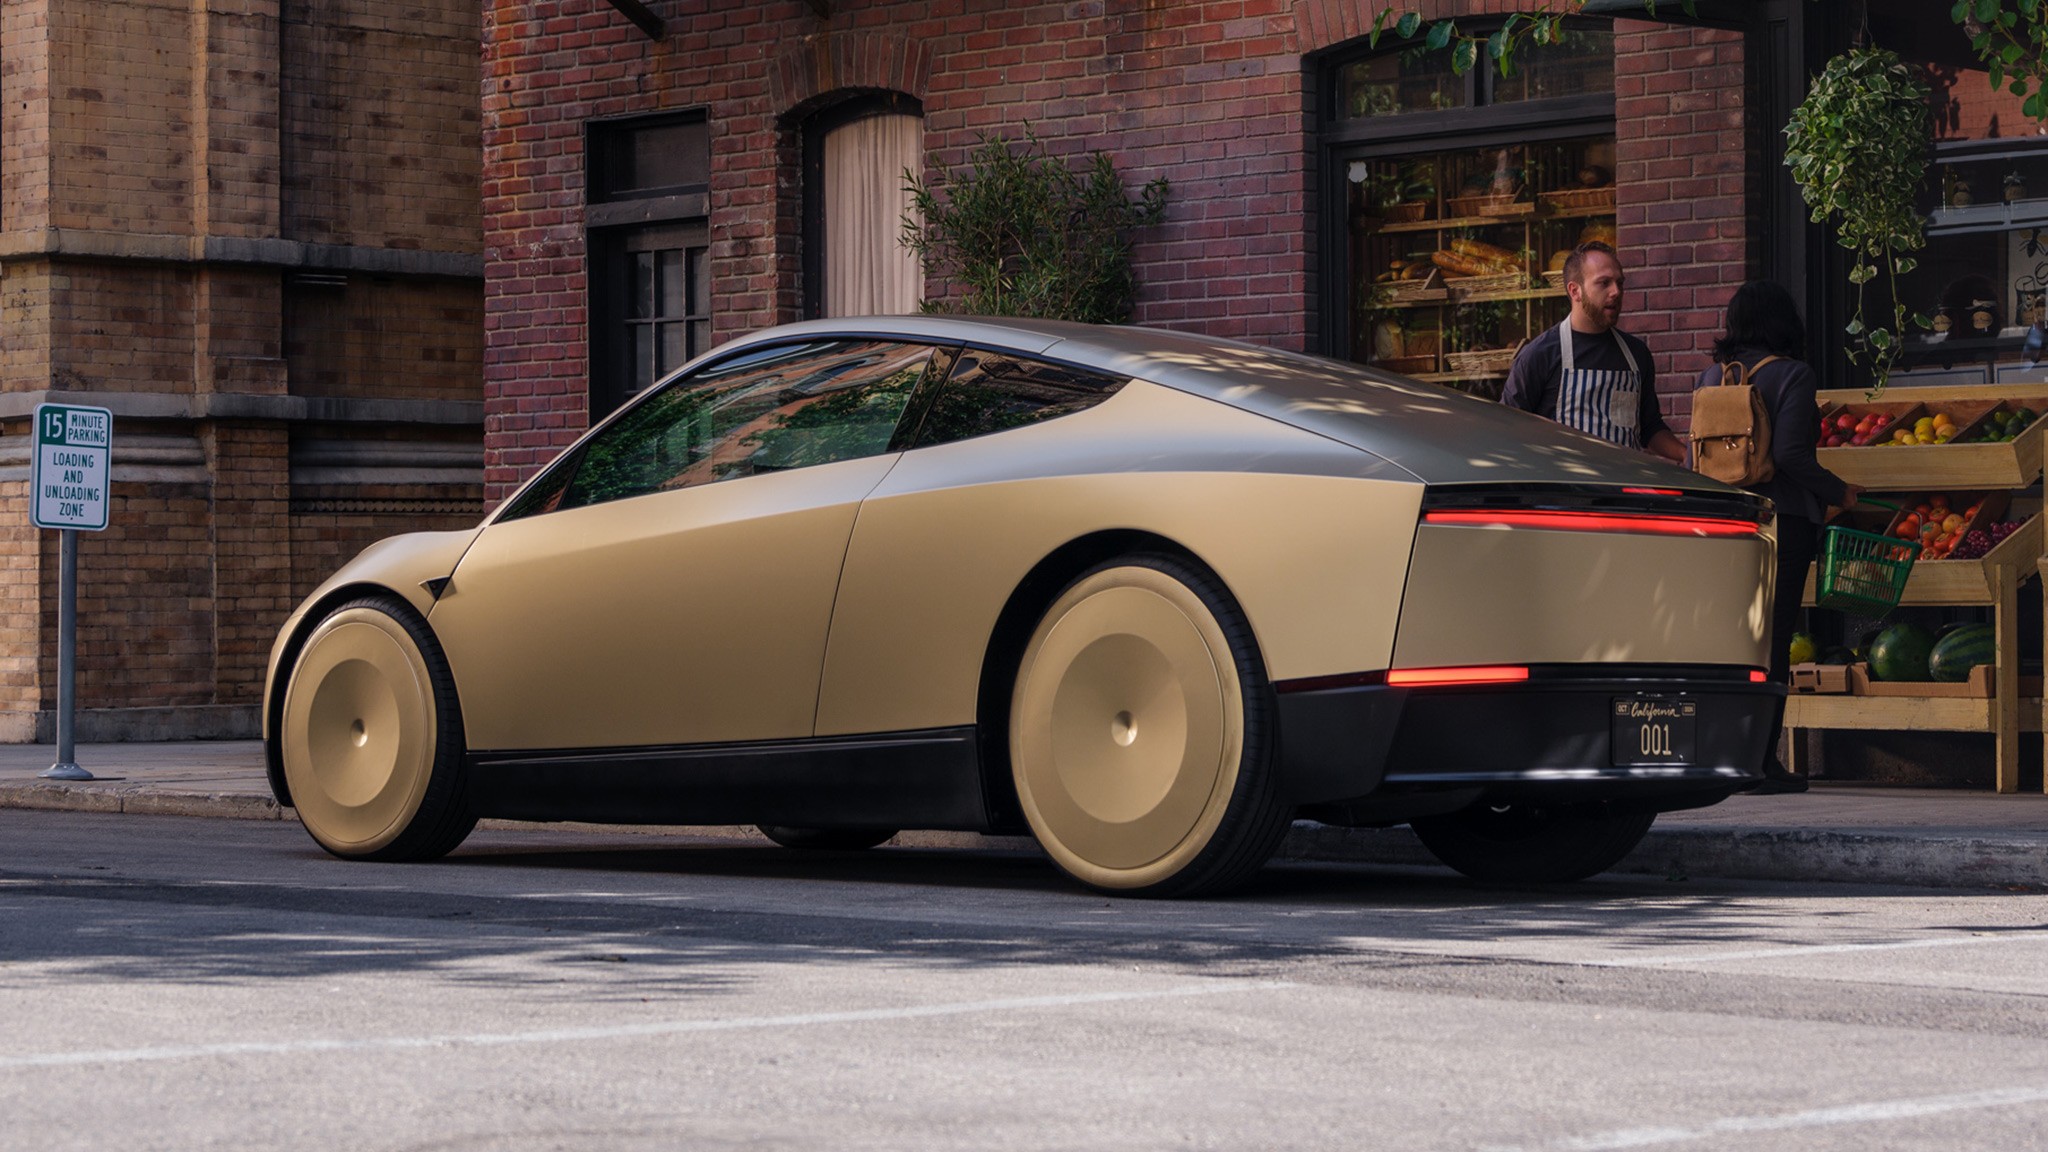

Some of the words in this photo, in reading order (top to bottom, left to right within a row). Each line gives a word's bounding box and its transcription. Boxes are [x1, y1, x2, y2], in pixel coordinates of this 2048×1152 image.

[45, 413, 63, 438] 15
[71, 414, 103, 429] MINUTE
[68, 428, 105, 443] PARKING
[53, 452, 94, 468] LOADING
[63, 470, 83, 484] AND
[45, 485, 99, 502] UNLOADING
[59, 502, 84, 517] ZONE
[1631, 702, 1681, 721] California
[1641, 724, 1672, 755] 001
